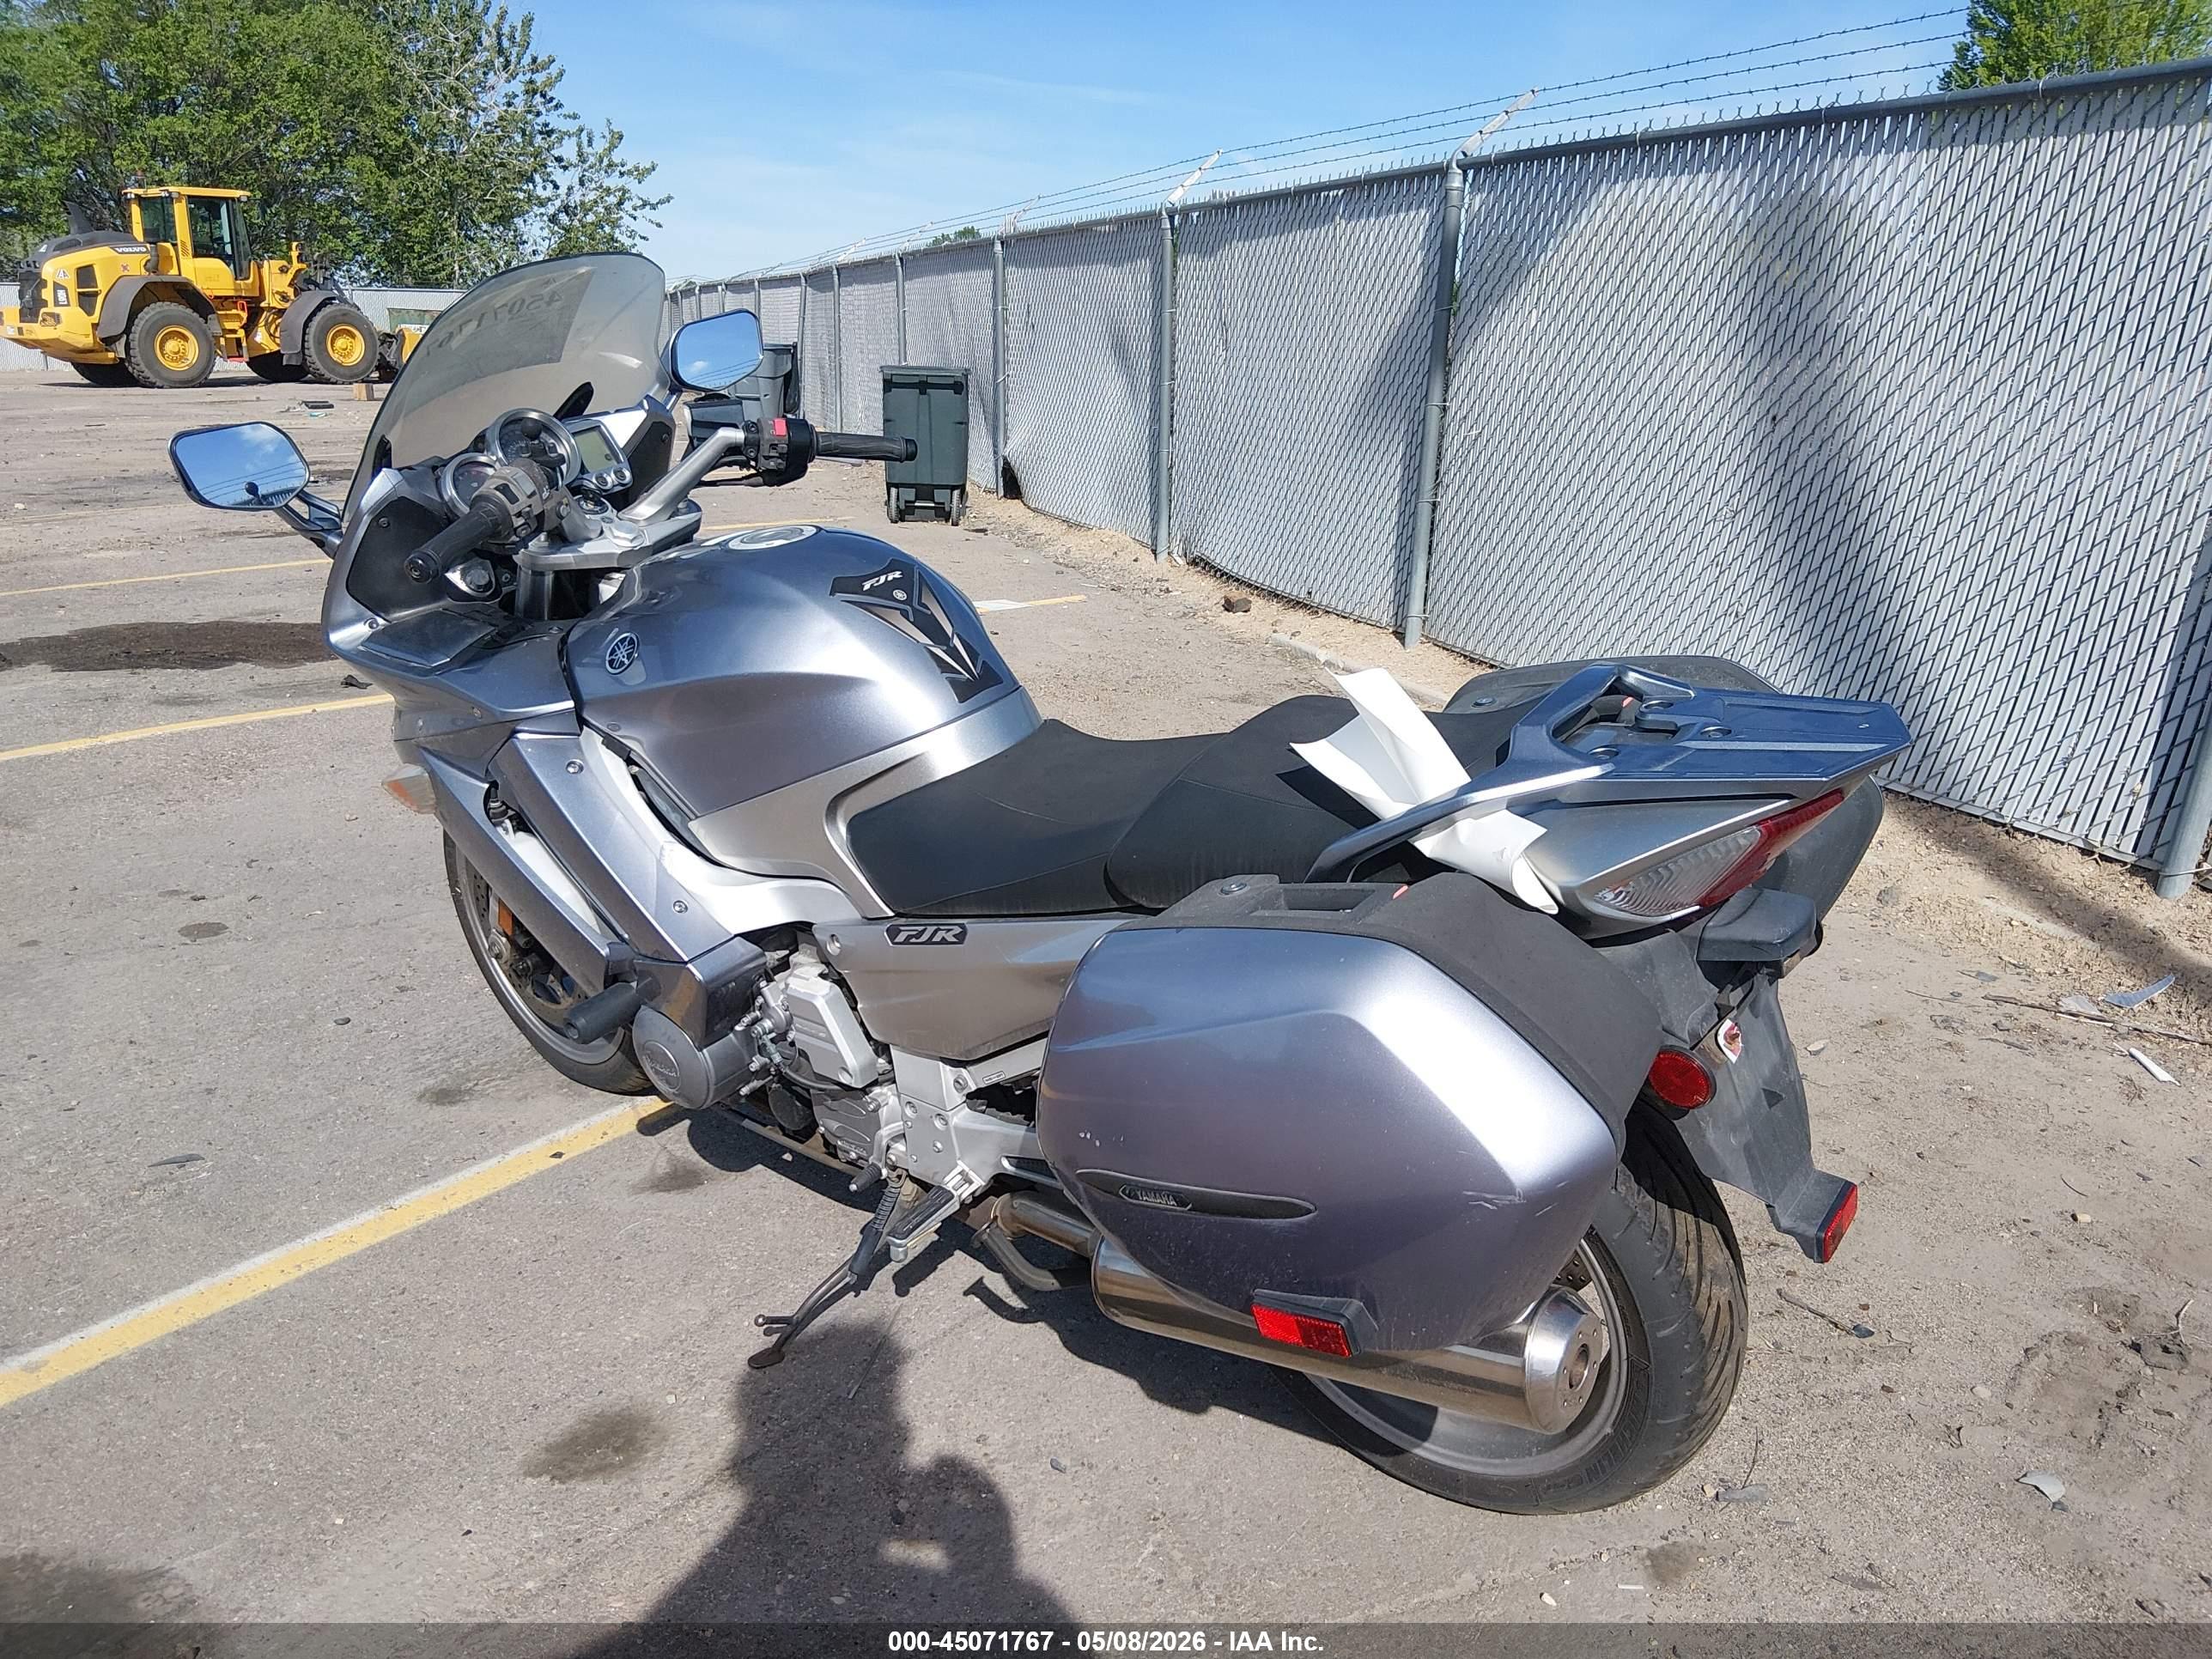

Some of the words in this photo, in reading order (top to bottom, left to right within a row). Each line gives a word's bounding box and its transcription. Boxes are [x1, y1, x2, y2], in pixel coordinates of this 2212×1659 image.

[861, 570, 903, 592] FJR
[893, 926, 963, 943] FJR
[1135, 1188, 1177, 1206] YAMAHA
